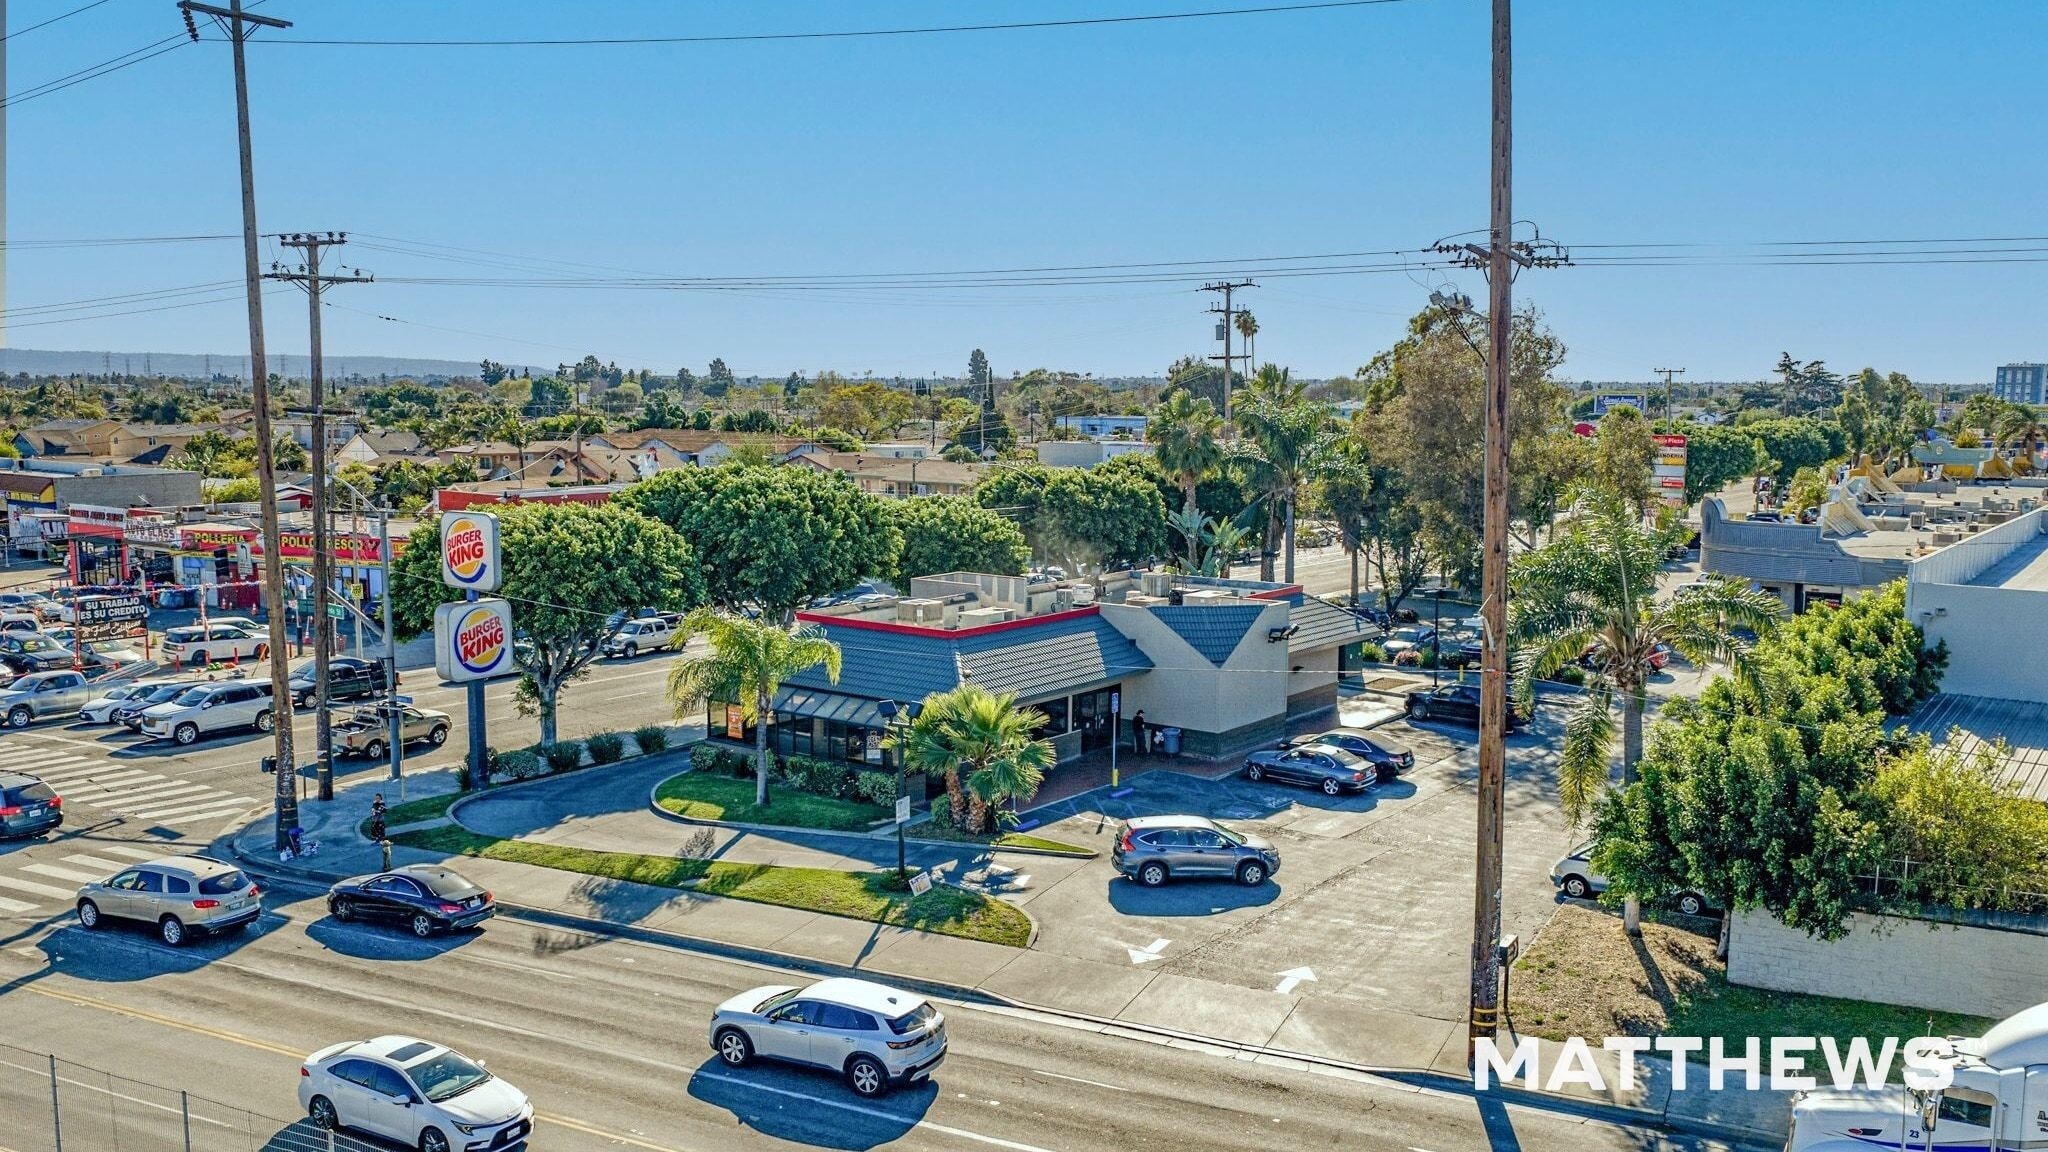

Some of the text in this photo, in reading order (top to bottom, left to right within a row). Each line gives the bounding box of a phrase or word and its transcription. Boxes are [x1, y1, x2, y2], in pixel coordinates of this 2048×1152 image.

[147, 527, 175, 539] GLASS
[194, 532, 245, 545] POLLERIA
[446, 529, 482, 551] BURGER
[448, 541, 484, 569] KING
[85, 597, 140, 610] SU TRABAJO
[80, 605, 146, 620] ES SU CREDITO
[459, 615, 501, 647] BURGER
[462, 627, 504, 664] KING
[1909, 1129, 1920, 1139] 23
